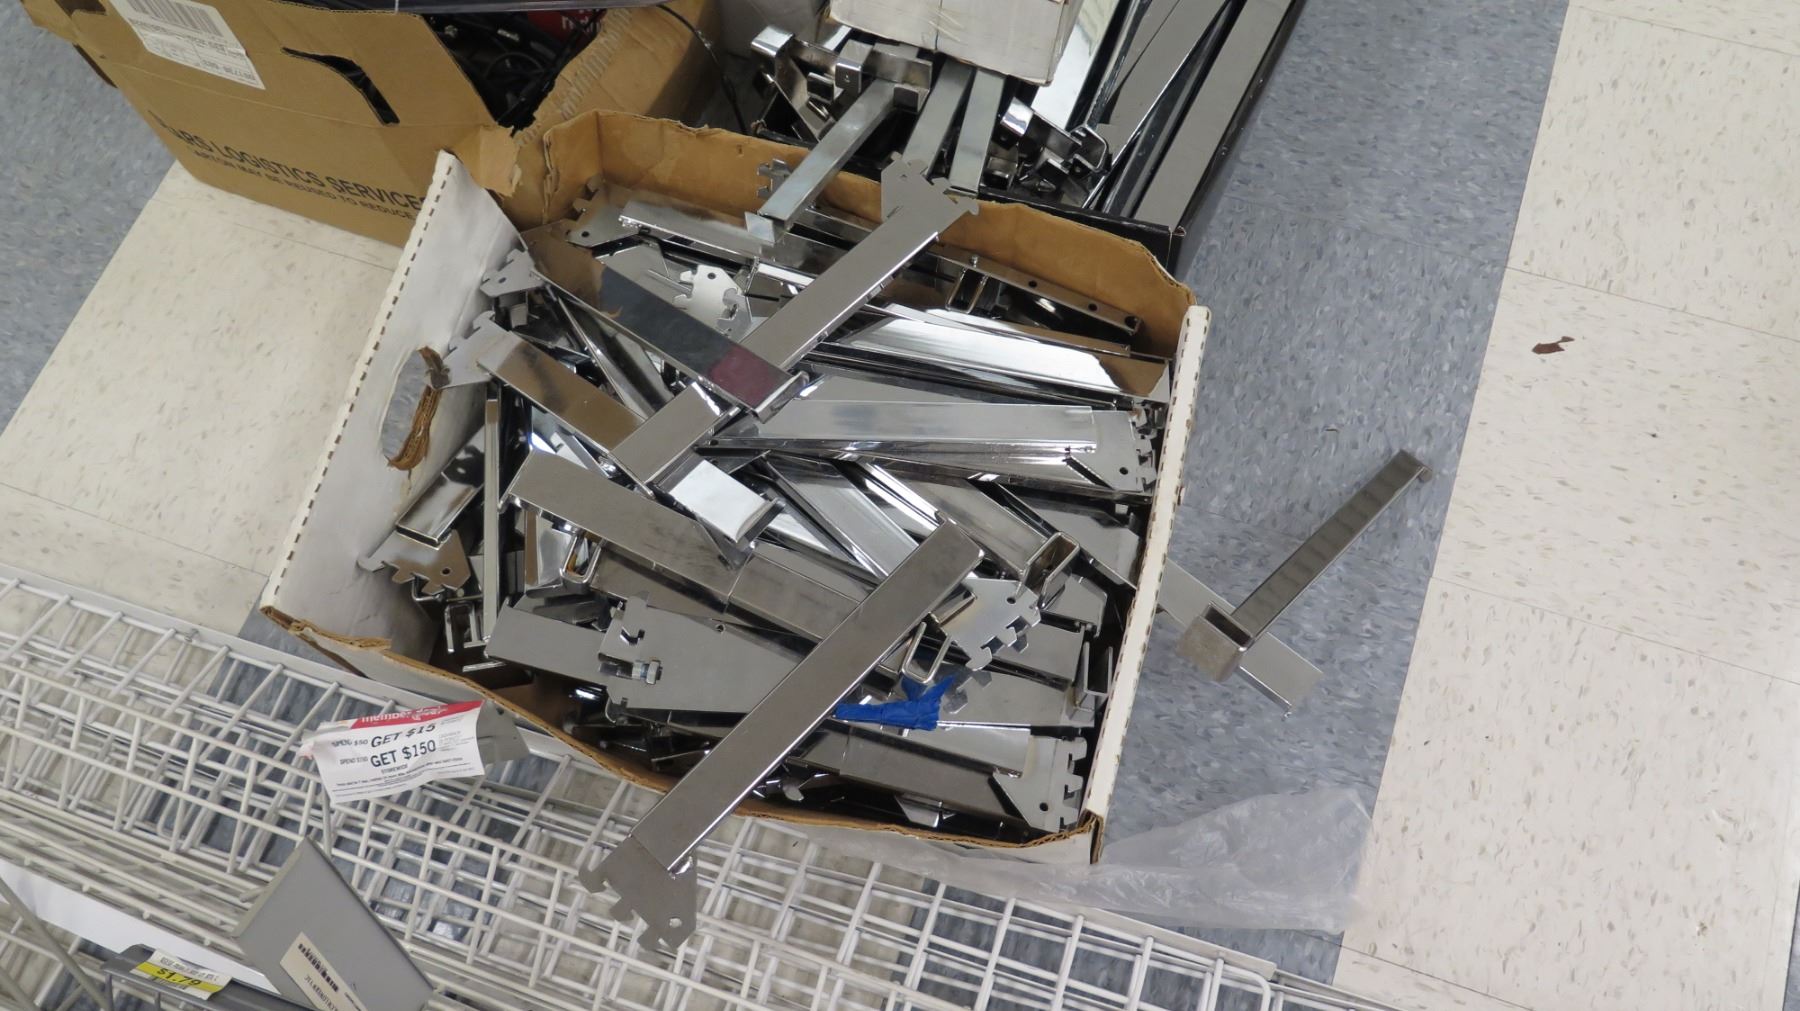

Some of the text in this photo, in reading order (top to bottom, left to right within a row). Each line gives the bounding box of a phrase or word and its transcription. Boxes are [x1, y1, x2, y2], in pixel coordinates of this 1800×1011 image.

[208, 140, 326, 188] LOGISTICS
[370, 732, 402, 748] GET
[405, 722, 437, 738] $15
[370, 750, 397, 768] GET
[401, 739, 437, 760] $150
[156, 967, 201, 986] $1.79
